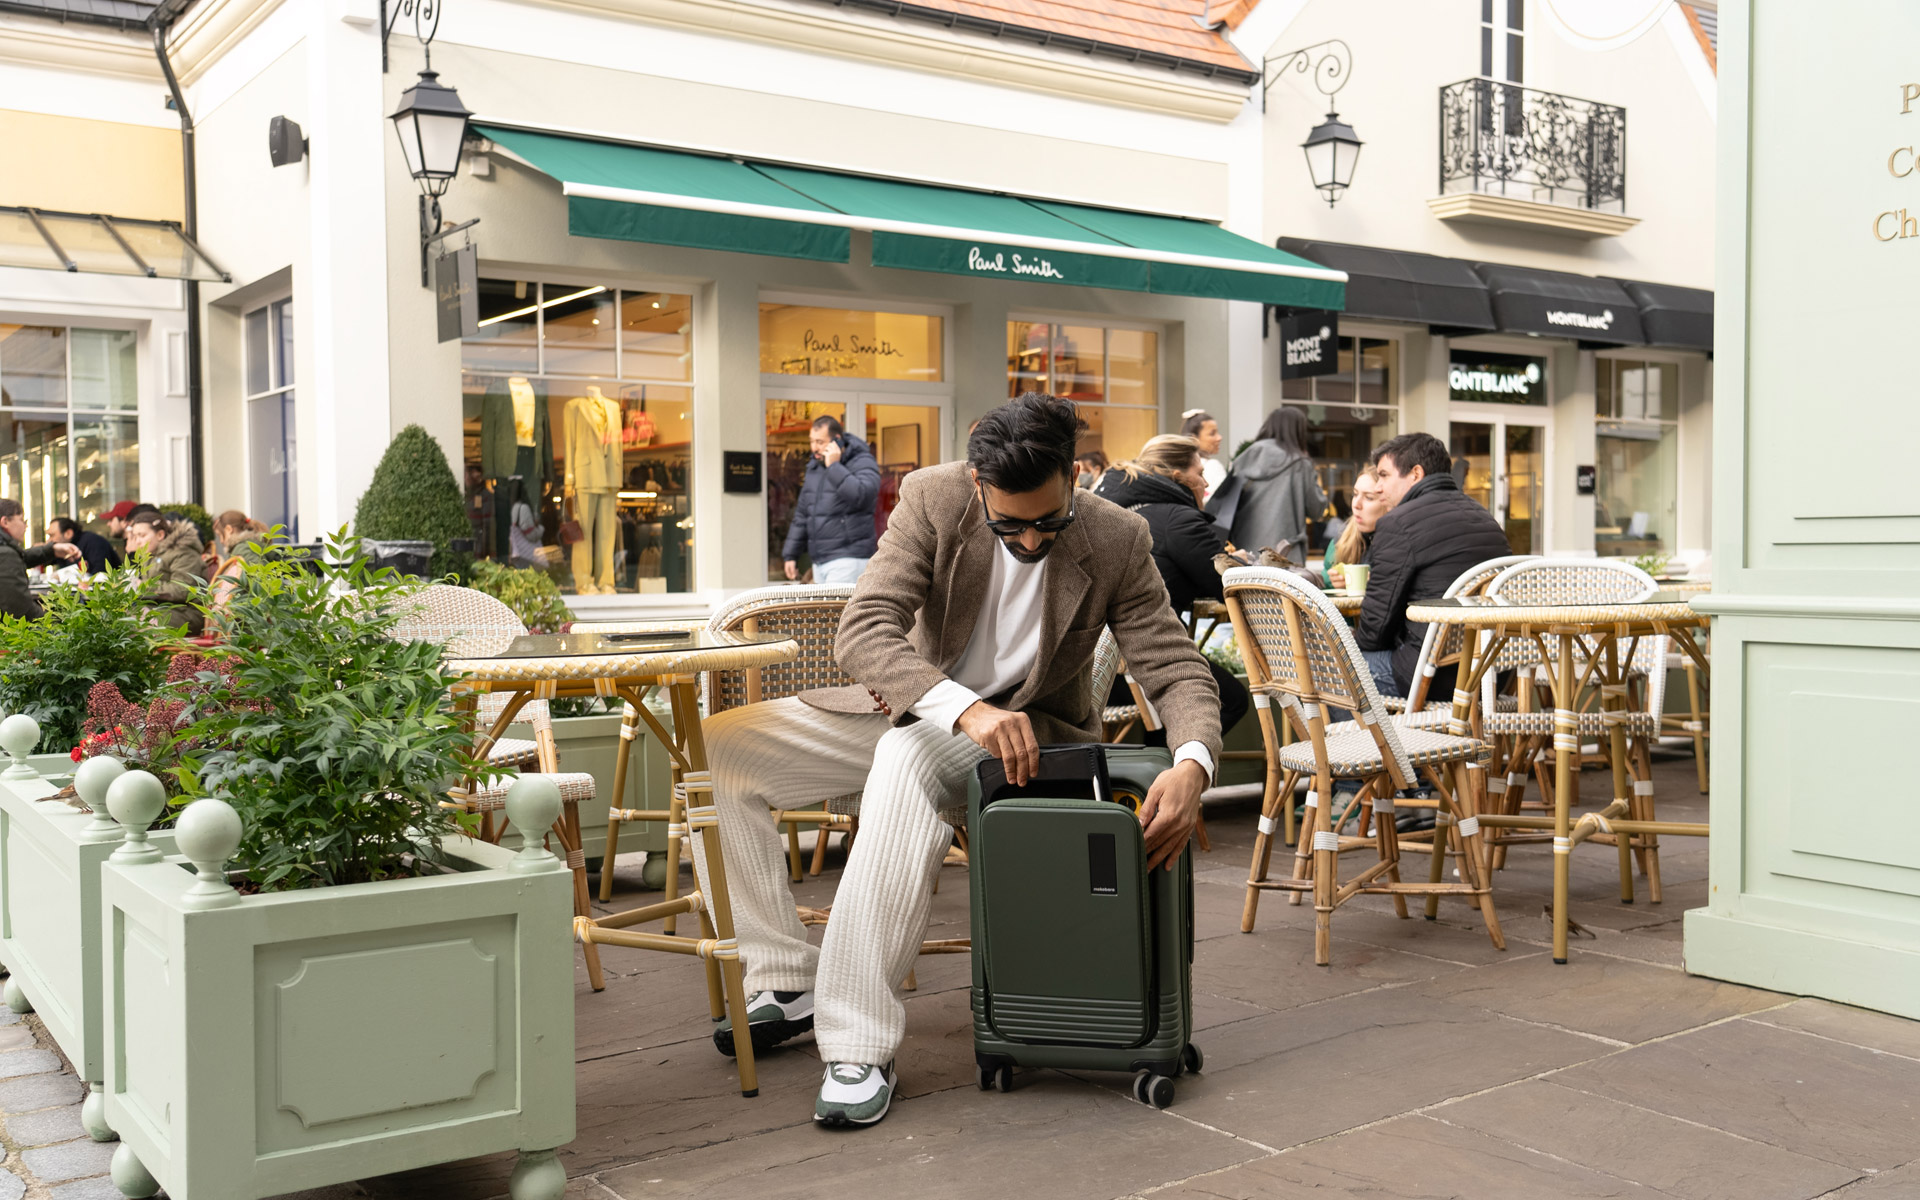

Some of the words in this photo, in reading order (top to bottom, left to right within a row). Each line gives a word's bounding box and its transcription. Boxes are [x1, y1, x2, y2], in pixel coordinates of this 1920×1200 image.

[968, 246, 1007, 272] Paul
[1011, 253, 1064, 279] Smith
[1546, 310, 1609, 330] MONTBLANC
[804, 328, 844, 352] Paul
[850, 334, 904, 357] Smith
[1286, 335, 1321, 353] MONT
[1286, 348, 1322, 366] BLANC
[1448, 369, 1529, 395] ONTBLANC
